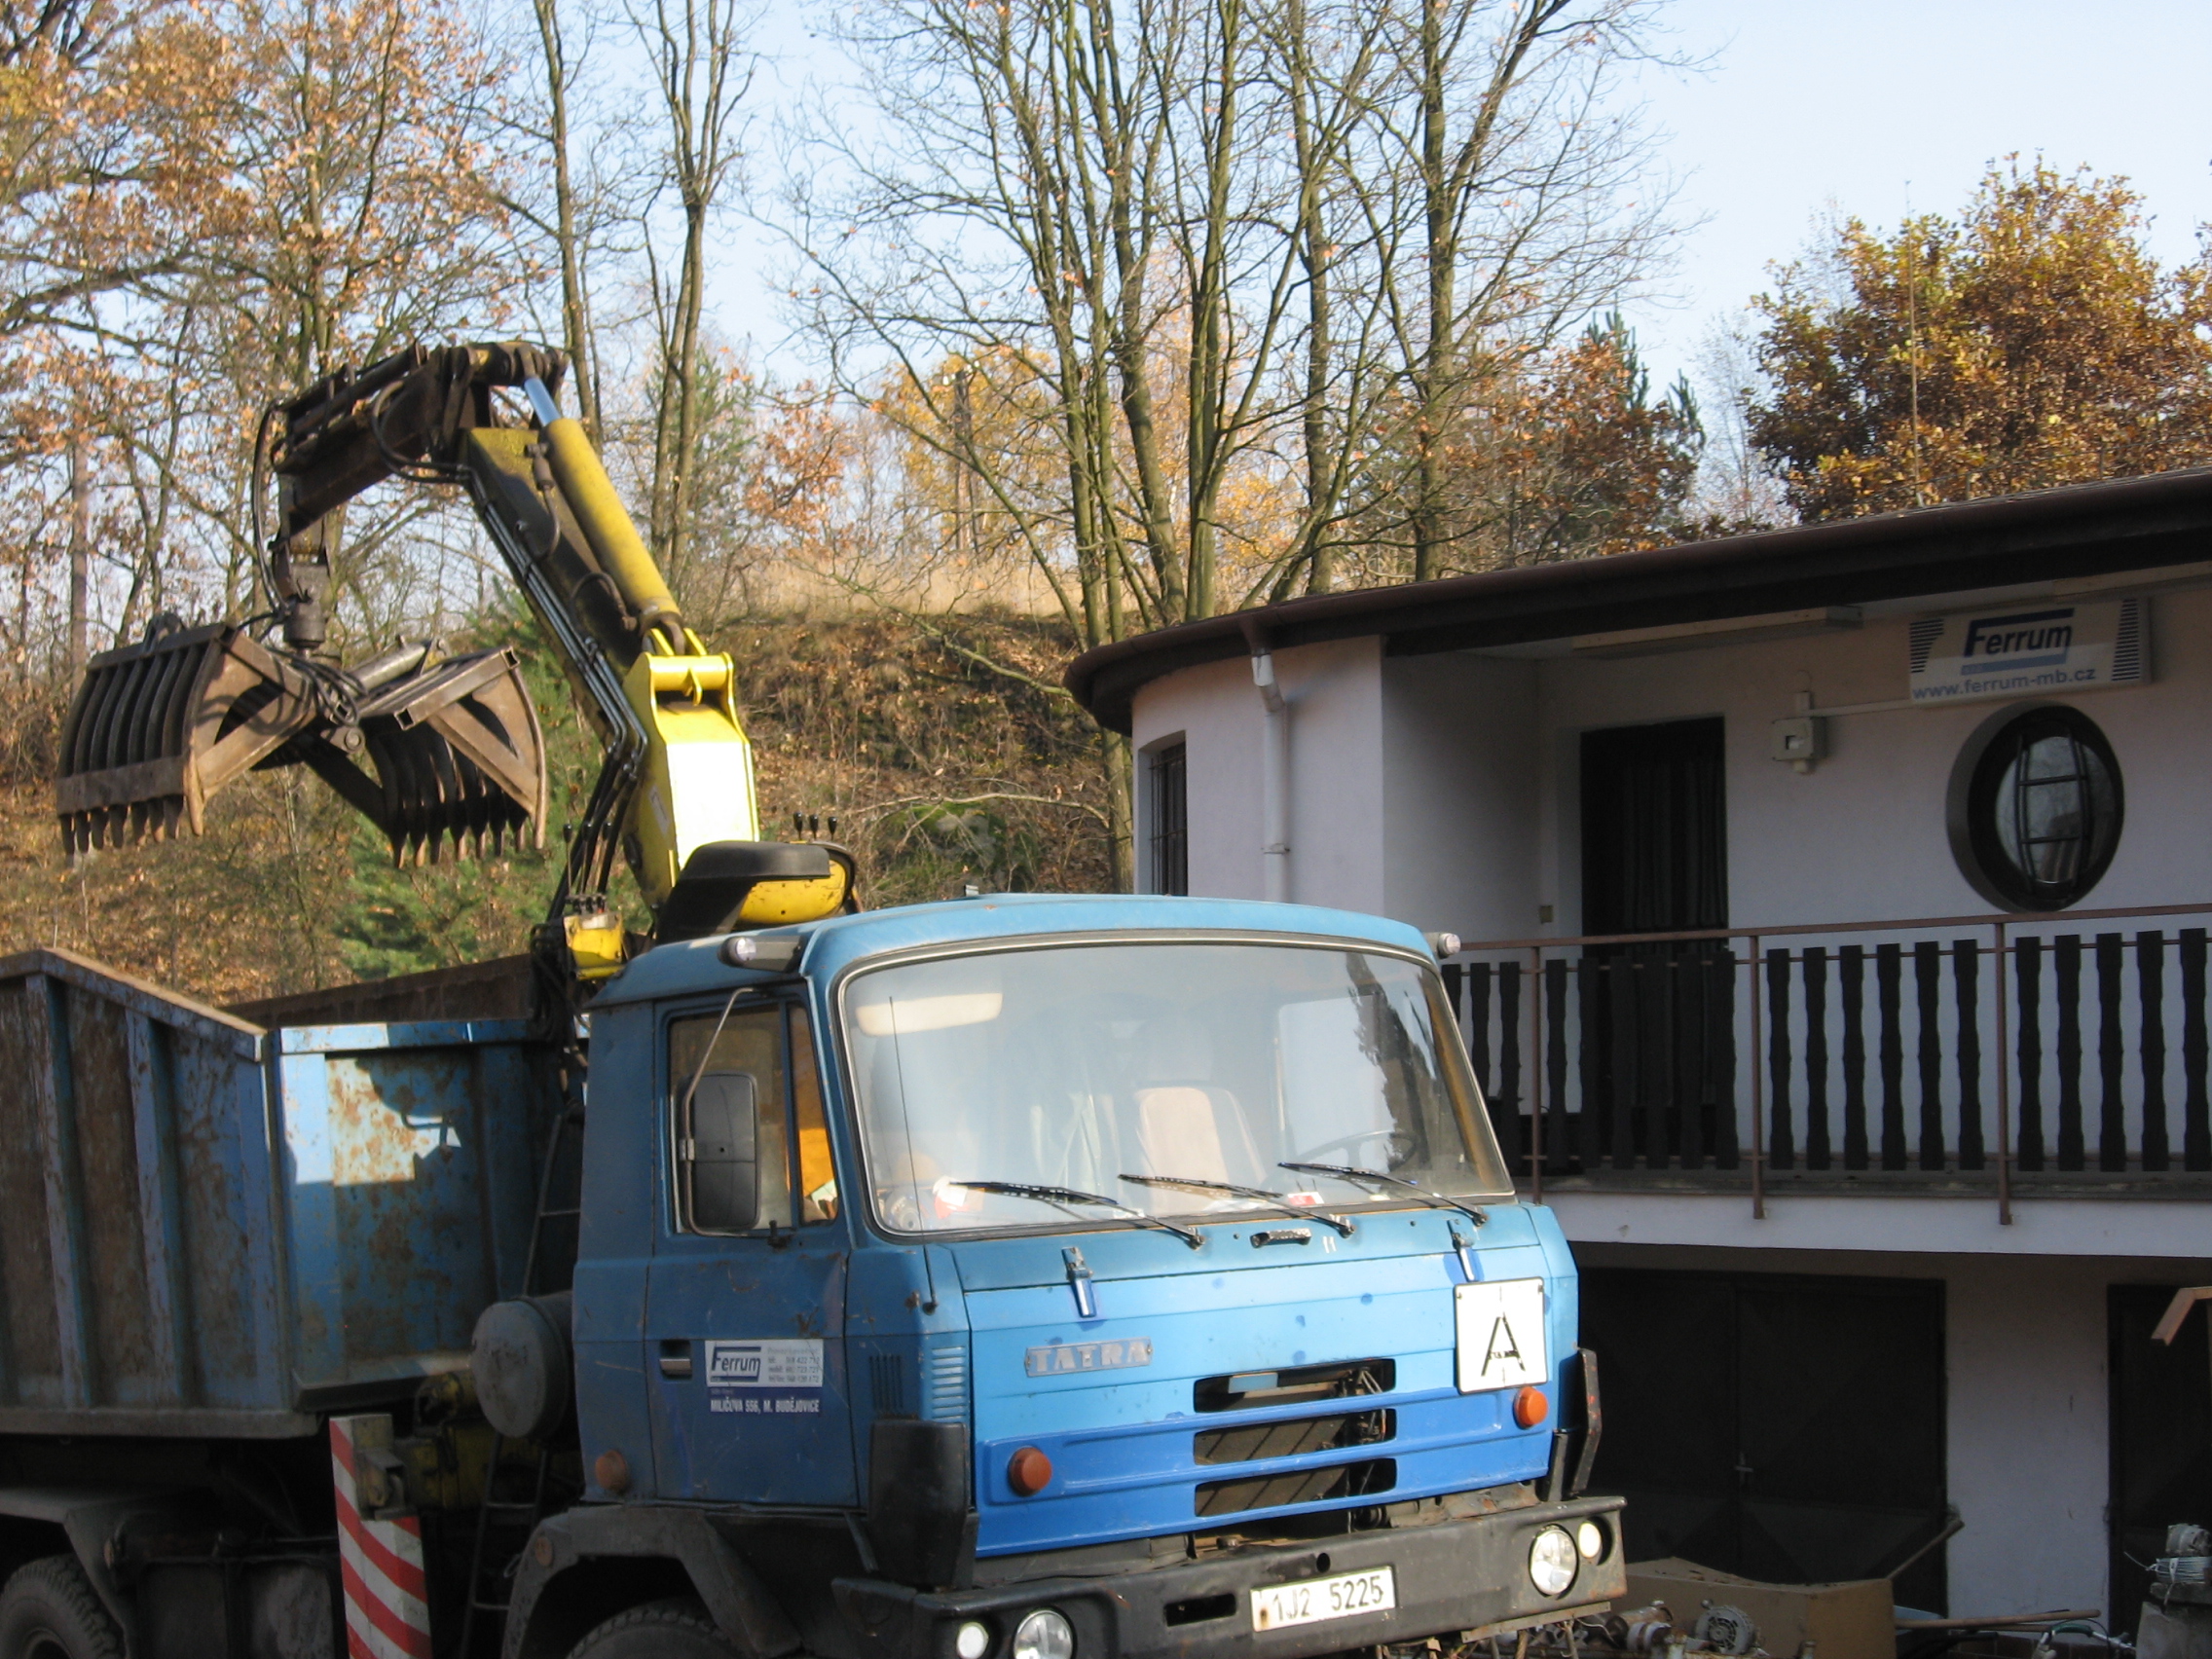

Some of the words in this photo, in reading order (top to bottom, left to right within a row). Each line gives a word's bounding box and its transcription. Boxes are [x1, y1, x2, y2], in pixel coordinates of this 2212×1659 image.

[1963, 608, 2075, 658] Ferrum
[1912, 668, 2097, 700] www.ferrum-mb.cz
[712, 1346, 761, 1374] Ferrum
[1031, 1342, 1148, 1372] TATRA
[1481, 1311, 1527, 1377] A
[1272, 1587, 1311, 1621] 1J2
[1329, 1575, 1383, 1611] 5225
